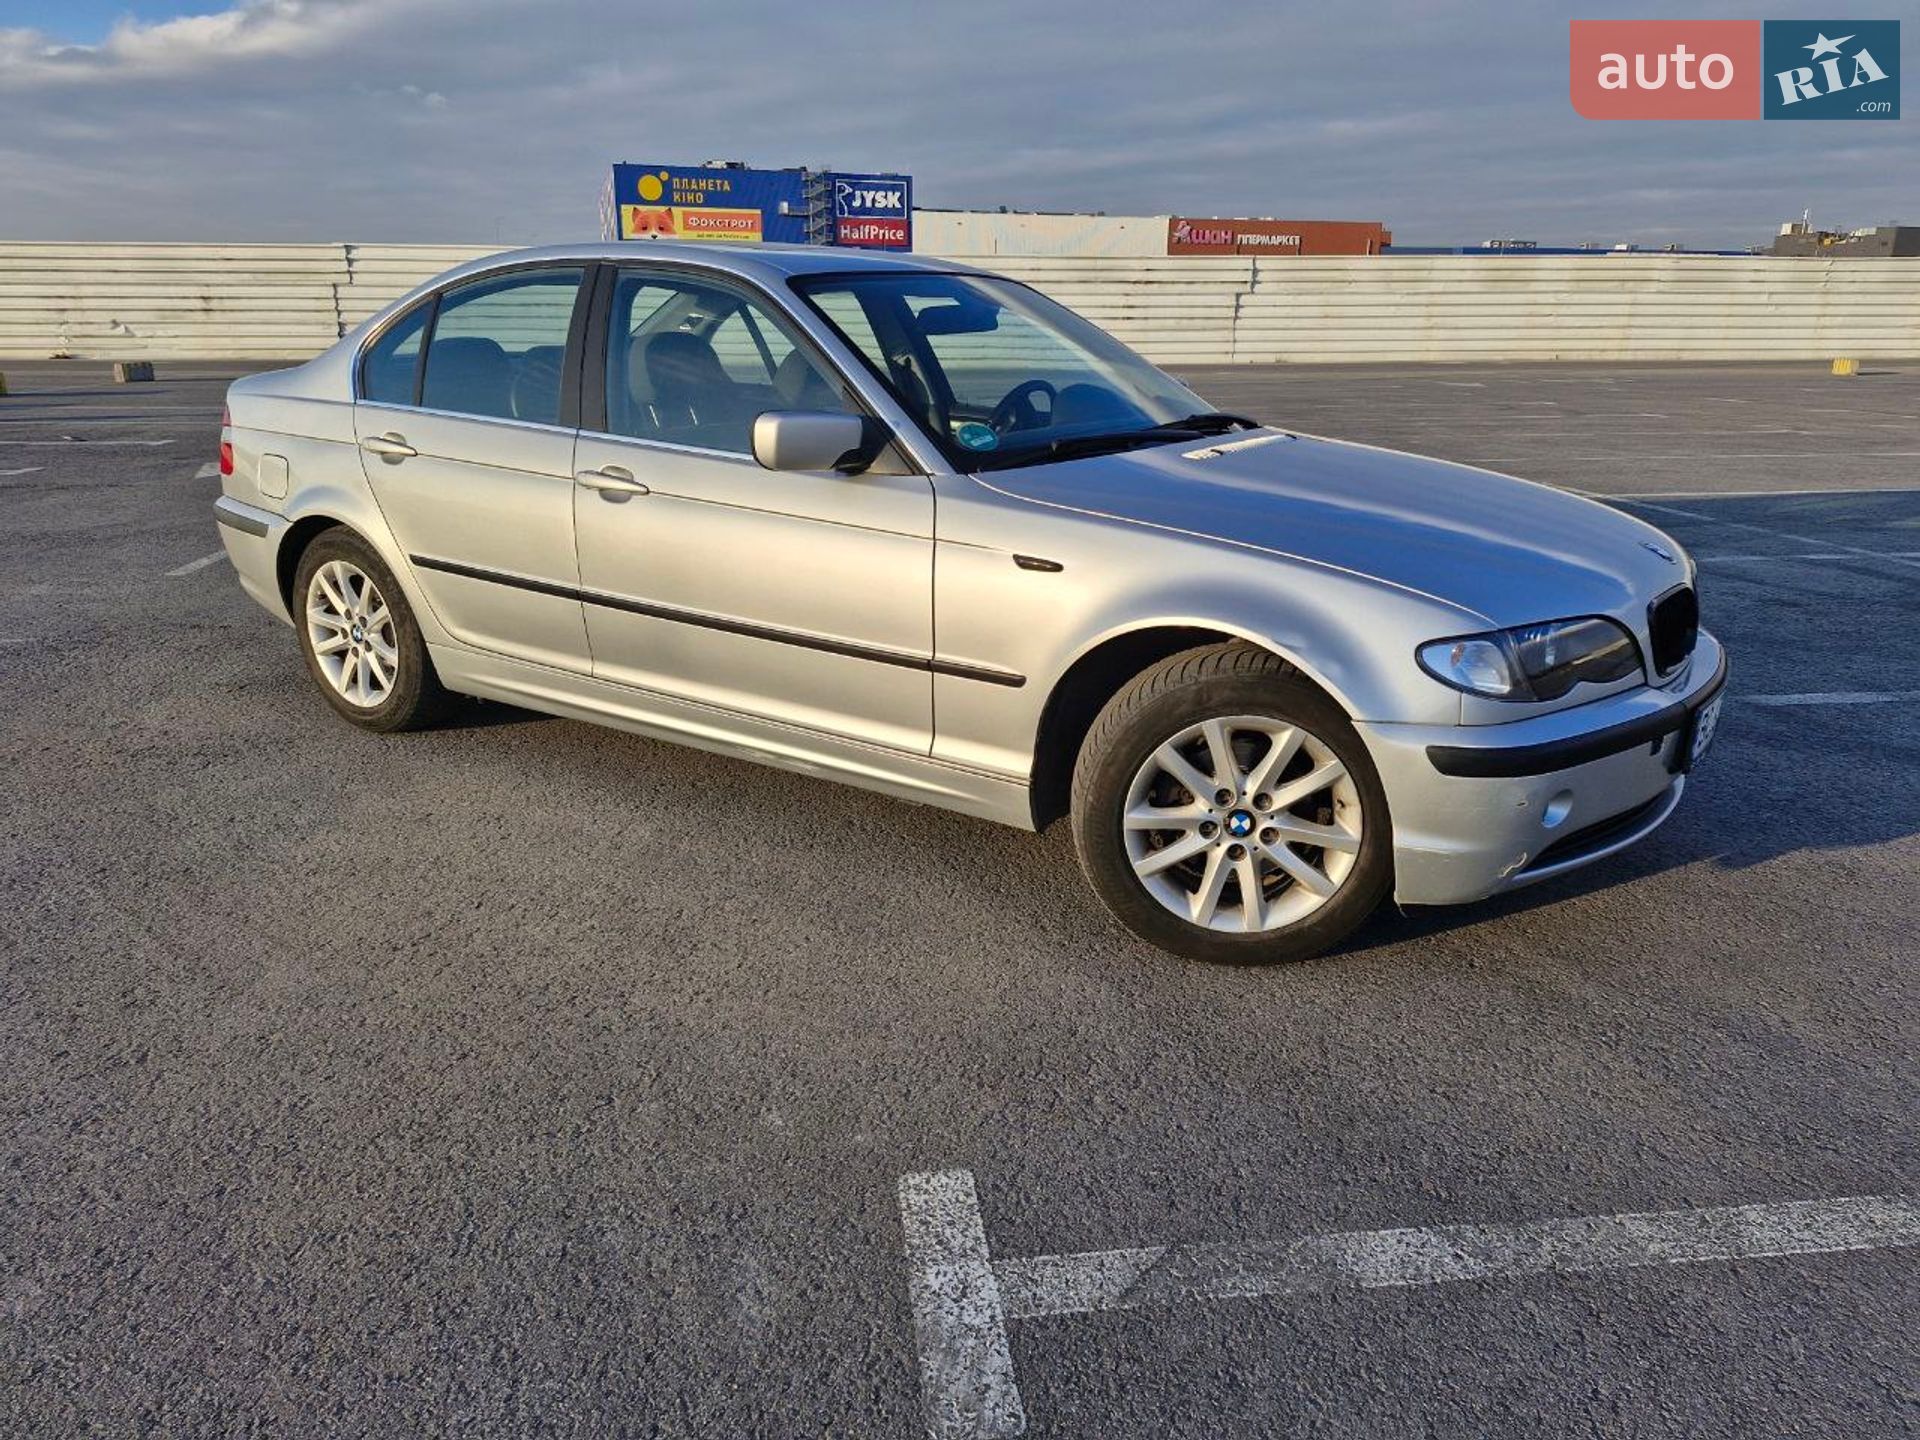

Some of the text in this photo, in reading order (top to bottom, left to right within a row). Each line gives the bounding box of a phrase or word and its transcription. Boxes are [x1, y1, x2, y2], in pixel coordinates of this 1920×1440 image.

[672, 177, 732, 191] ПЛАНЕТА
[673, 192, 704, 204] КІНО
[852, 190, 903, 208] JYSK
[688, 215, 754, 229] ФОКСТРОТ
[840, 224, 905, 240] HalfPrice
[1237, 234, 1300, 246] ГІПЕРМАРКЕТ
